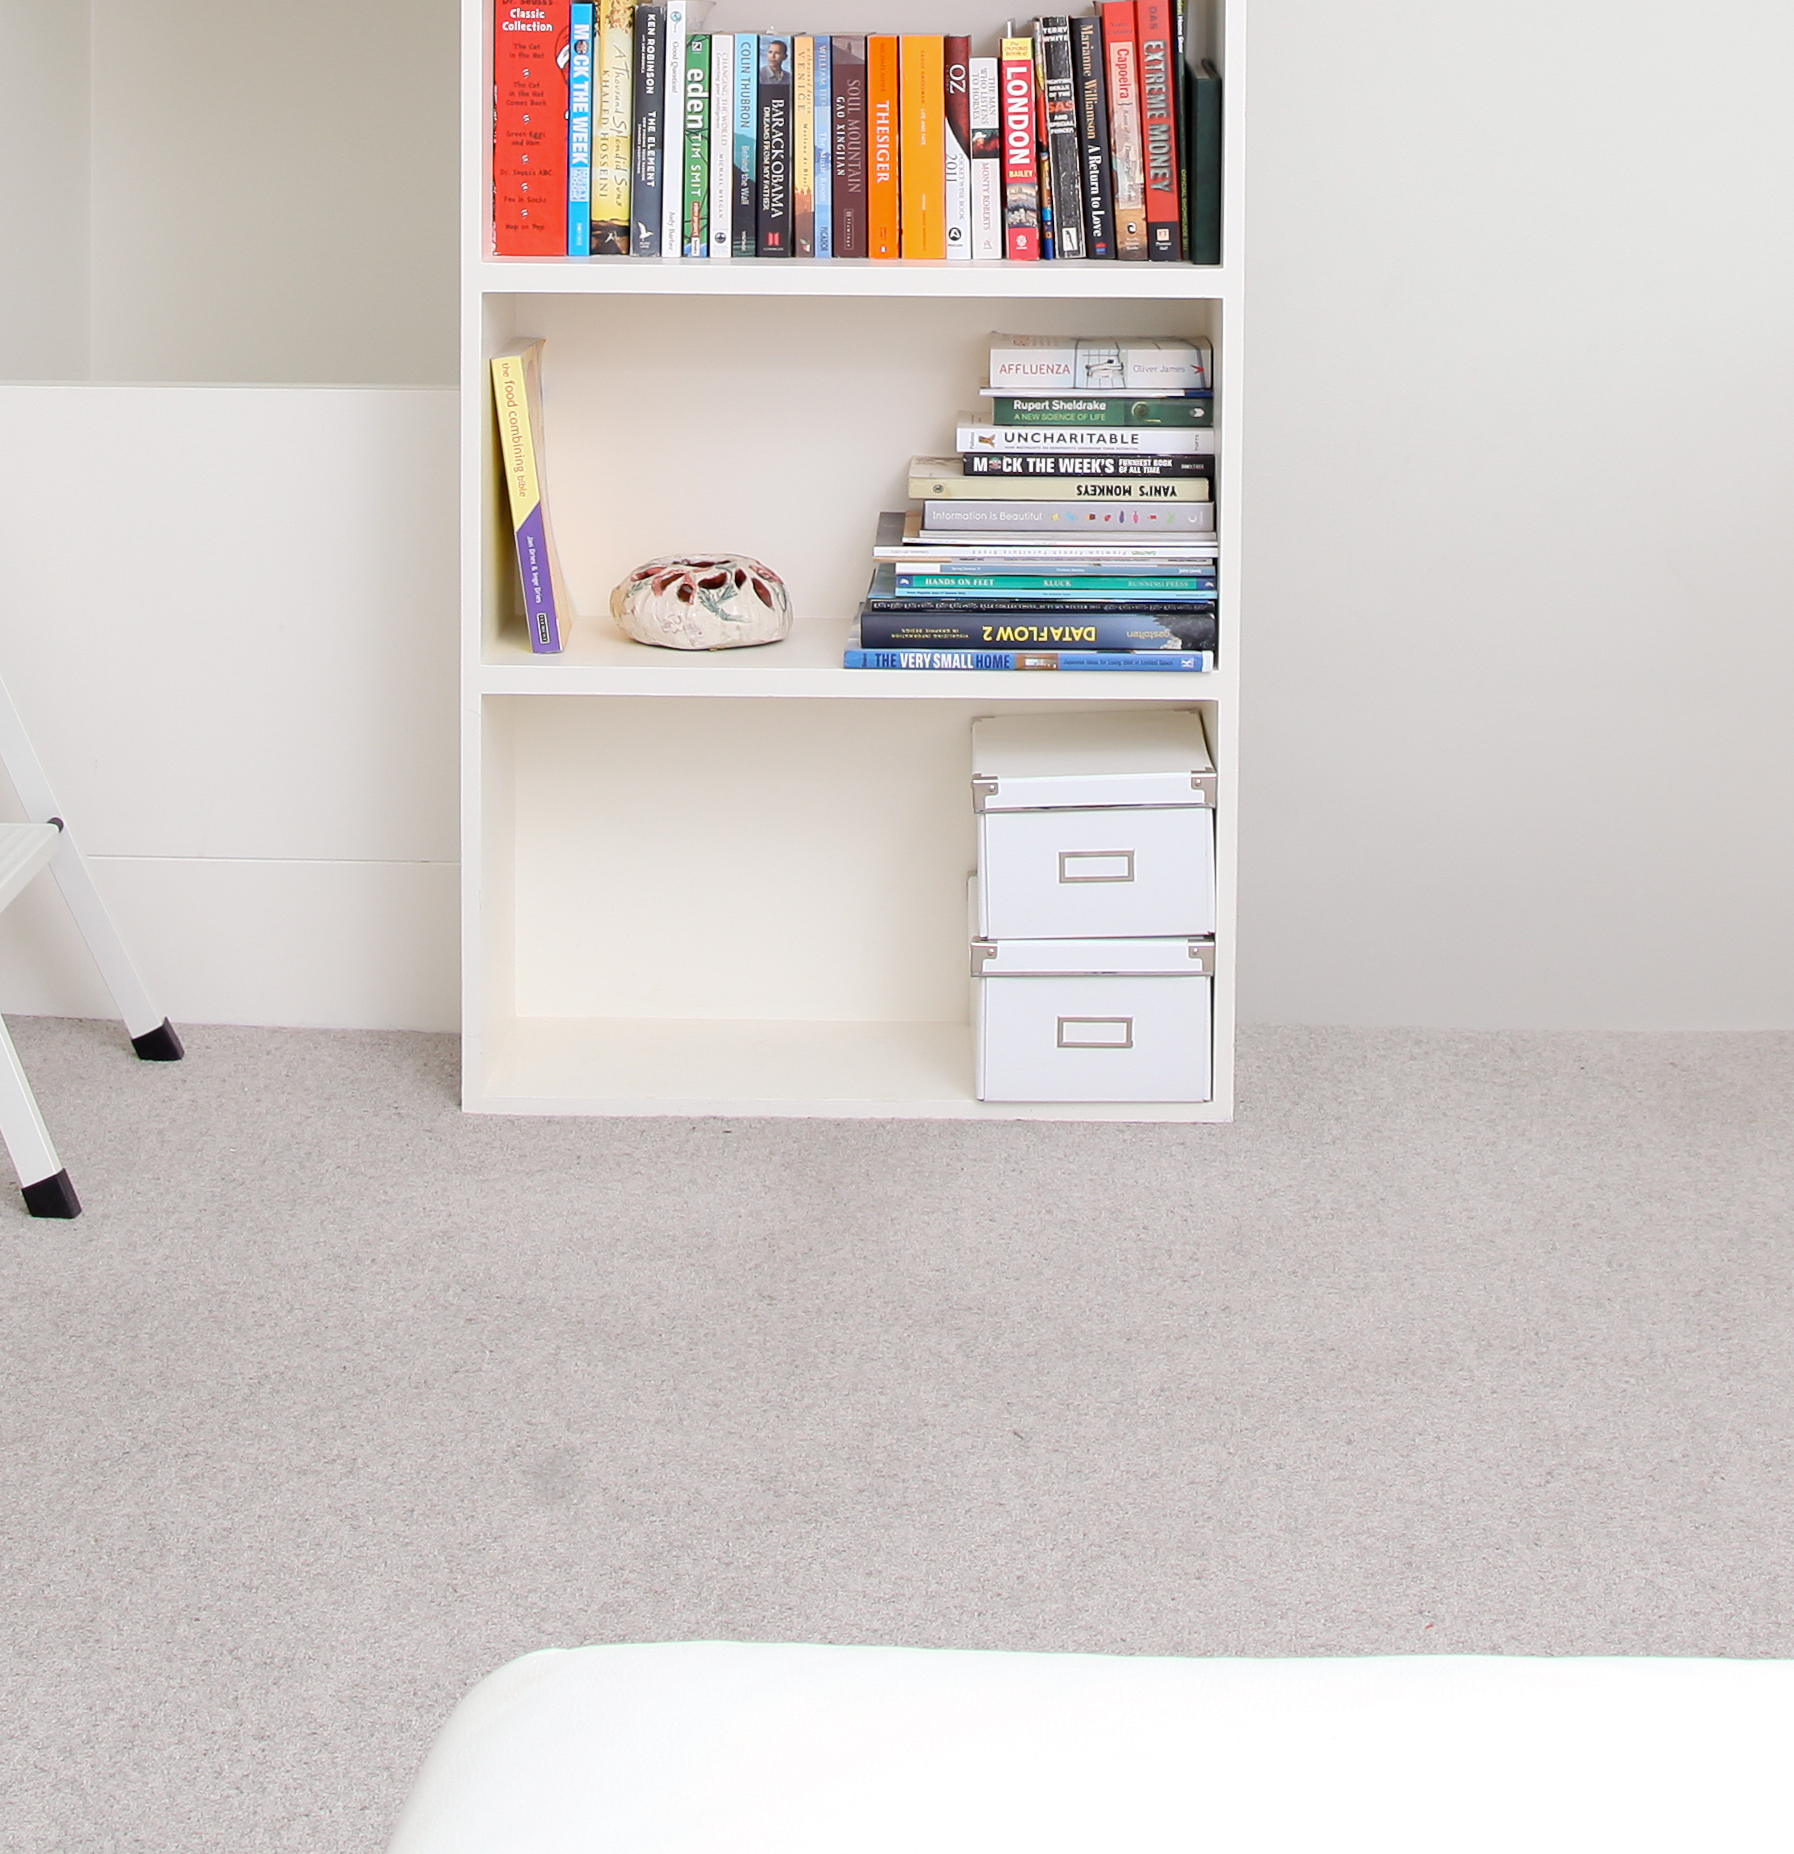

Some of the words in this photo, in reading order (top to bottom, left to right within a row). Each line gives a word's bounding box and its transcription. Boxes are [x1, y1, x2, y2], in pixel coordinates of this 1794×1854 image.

[501, 20, 554, 33] Collection
[509, 8, 546, 20] Classic
[646, 14, 657, 37] KEN
[1149, 6, 1158, 30] DAS
[613, 45, 627, 60] A
[671, 41, 681, 60] Good
[740, 41, 751, 74] COLIN
[1080, 24, 1096, 77] Marianne
[645, 38, 656, 95] ROBINSON
[669, 61, 681, 94] Question!
[720, 52, 729, 96] CHANGING
[819, 45, 828, 86] WILLIAM
[949, 63, 967, 94] OZ
[972, 72, 981, 85] TO
[980, 67, 989, 90] WHO
[1115, 48, 1132, 100] Capoeira
[612, 61, 630, 114] Thousand
[797, 51, 806, 112] VENICE
[988, 76, 996, 96] THE
[1144, 40, 1168, 119] EXTREME
[572, 81, 590, 114] THE
[599, 70, 610, 126] KHALED
[686, 68, 709, 130] eden
[720, 98, 729, 114] THE
[740, 77, 751, 128] THUBRON
[836, 96, 846, 118] GAO
[847, 79, 861, 115] SOUL
[972, 86, 981, 120] HORSES
[980, 91, 989, 125] LISTENS
[988, 98, 996, 116] MAN
[1049, 100, 1074, 113] SAS
[1083, 79, 1099, 139] Williamson
[646, 111, 657, 134] THE
[762, 106, 772, 139] DREAMS
[1005, 66, 1031, 164] LONDON
[570, 115, 590, 165] WEEK
[720, 115, 729, 146] WORLD
[771, 99, 786, 159] BARACK
[819, 132, 828, 148] The
[876, 99, 890, 184] THESIGER
[609, 116, 630, 171] Splendid
[691, 133, 704, 159] TIM
[762, 139, 772, 165] FROM
[835, 124, 846, 177] XINGJIAN
[847, 119, 862, 194] MOUNTAIN
[1087, 145, 1102, 154] A
[597, 132, 610, 198] HOSSEINI
[646, 135, 657, 188] ELEMENT
[740, 145, 751, 172] Behind
[819, 150, 828, 174] Music
[946, 153, 958, 184] 2011
[1148, 123, 1173, 193] MONEY
[691, 164, 703, 197] SMIT
[740, 173, 751, 187] the
[762, 166, 772, 179] MY
[982, 162, 991, 193] MONTY
[1009, 169, 1033, 178] BAILEY
[1088, 156, 1104, 195] Return
[614, 178, 630, 208] Suns
[740, 187, 751, 205] Wall
[761, 179, 772, 211] FATHER
[770, 161, 786, 218] OBAMA
[819, 177, 828, 202] Room
[1090, 197, 1103, 209] to
[982, 194, 991, 231] ROBERTS
[1091, 210, 1105, 237] Love
[820, 226, 828, 252] PICADOR
[501, 362, 512, 377] the
[999, 363, 1071, 375] AFFLUENZA
[1133, 363, 1159, 374] Oliver
[1159, 364, 1186, 374] James
[505, 379, 520, 408] food
[1013, 399, 1053, 413] Rupert
[1054, 399, 1107, 410] Sheldrake
[1014, 413, 1020, 421] A
[1020, 413, 1041, 421] NEW
[1041, 413, 1074, 421] SCIENCE
[1076, 413, 1087, 421] OF
[1089, 413, 1105, 421] LIFE
[508, 410, 526, 473] combining
[1003, 432, 1140, 444] UNCHARITABLE
[1026, 457, 1056, 473] THE
[1058, 457, 1115, 474] WEEK'S
[516, 474, 528, 497] bible
[1076, 484, 1132, 496] MONKEYS
[1139, 485, 1177, 496] YANI'S
[932, 510, 986, 522] Information
[988, 510, 998, 521] is
[999, 510, 1043, 521] Beautiful
[925, 578, 955, 586] HANDS
[958, 578, 971, 586] ON
[973, 578, 995, 586] FEET
[982, 626, 994, 642] 2
[995, 626, 1097, 642] DATAFLOW
[875, 653, 897, 668] THE
[899, 653, 933, 669] VERY
[933, 653, 974, 669] SMALL
[976, 653, 1010, 669] HOME
